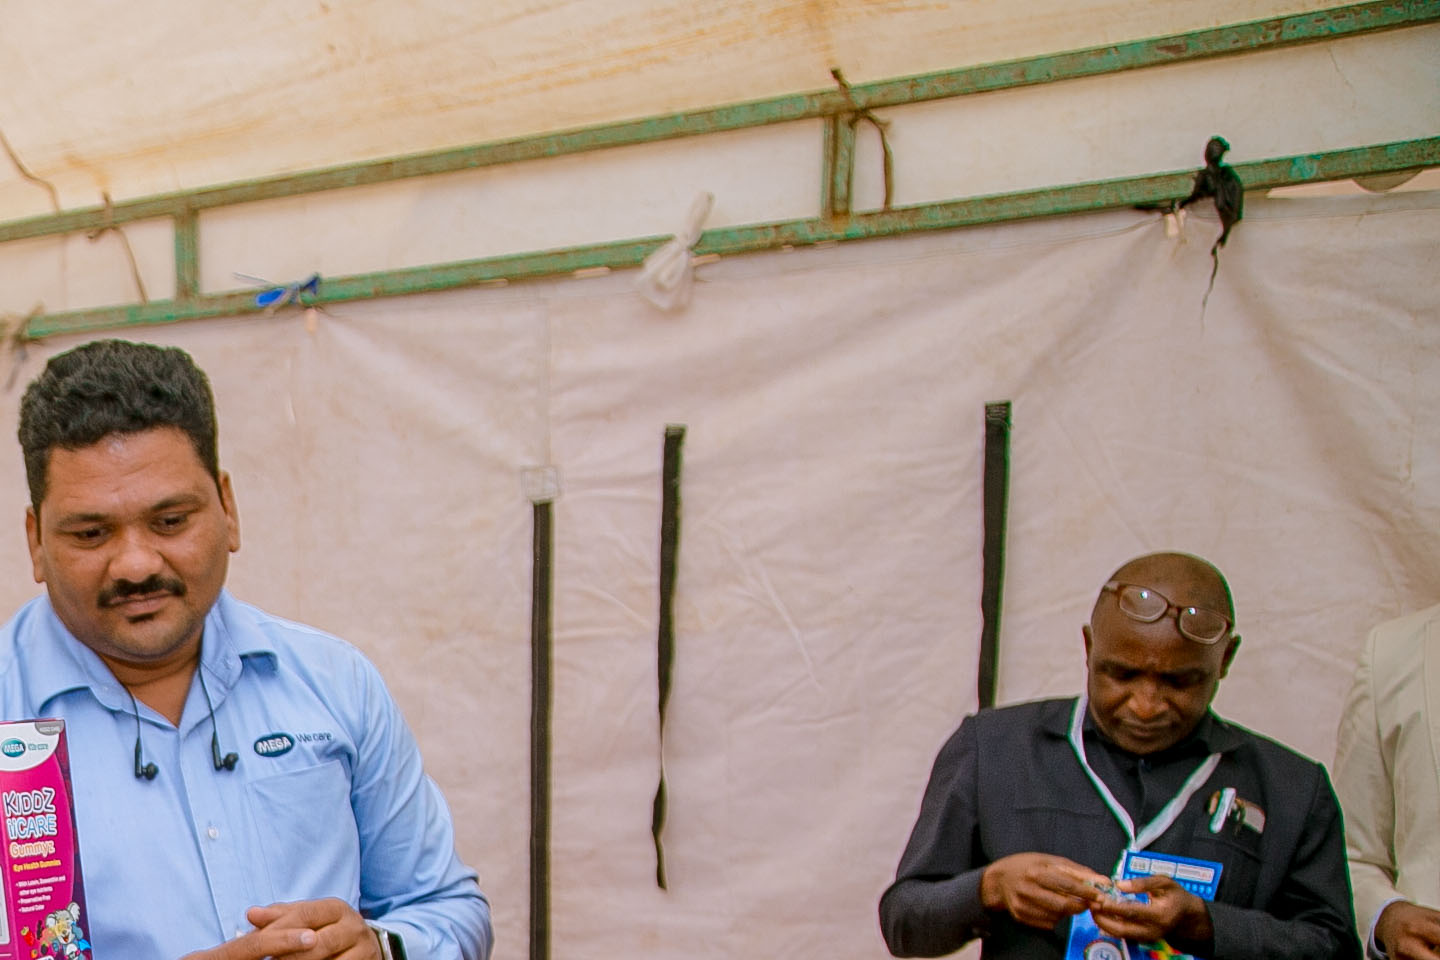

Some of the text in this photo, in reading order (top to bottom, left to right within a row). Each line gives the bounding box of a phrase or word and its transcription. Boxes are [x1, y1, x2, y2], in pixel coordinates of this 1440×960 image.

[4, 744, 24, 753] MEGA
[257, 732, 332, 753] MEGA We care
[3, 788, 56, 816] KIDDZ
[10, 840, 55, 858] Gummyz
